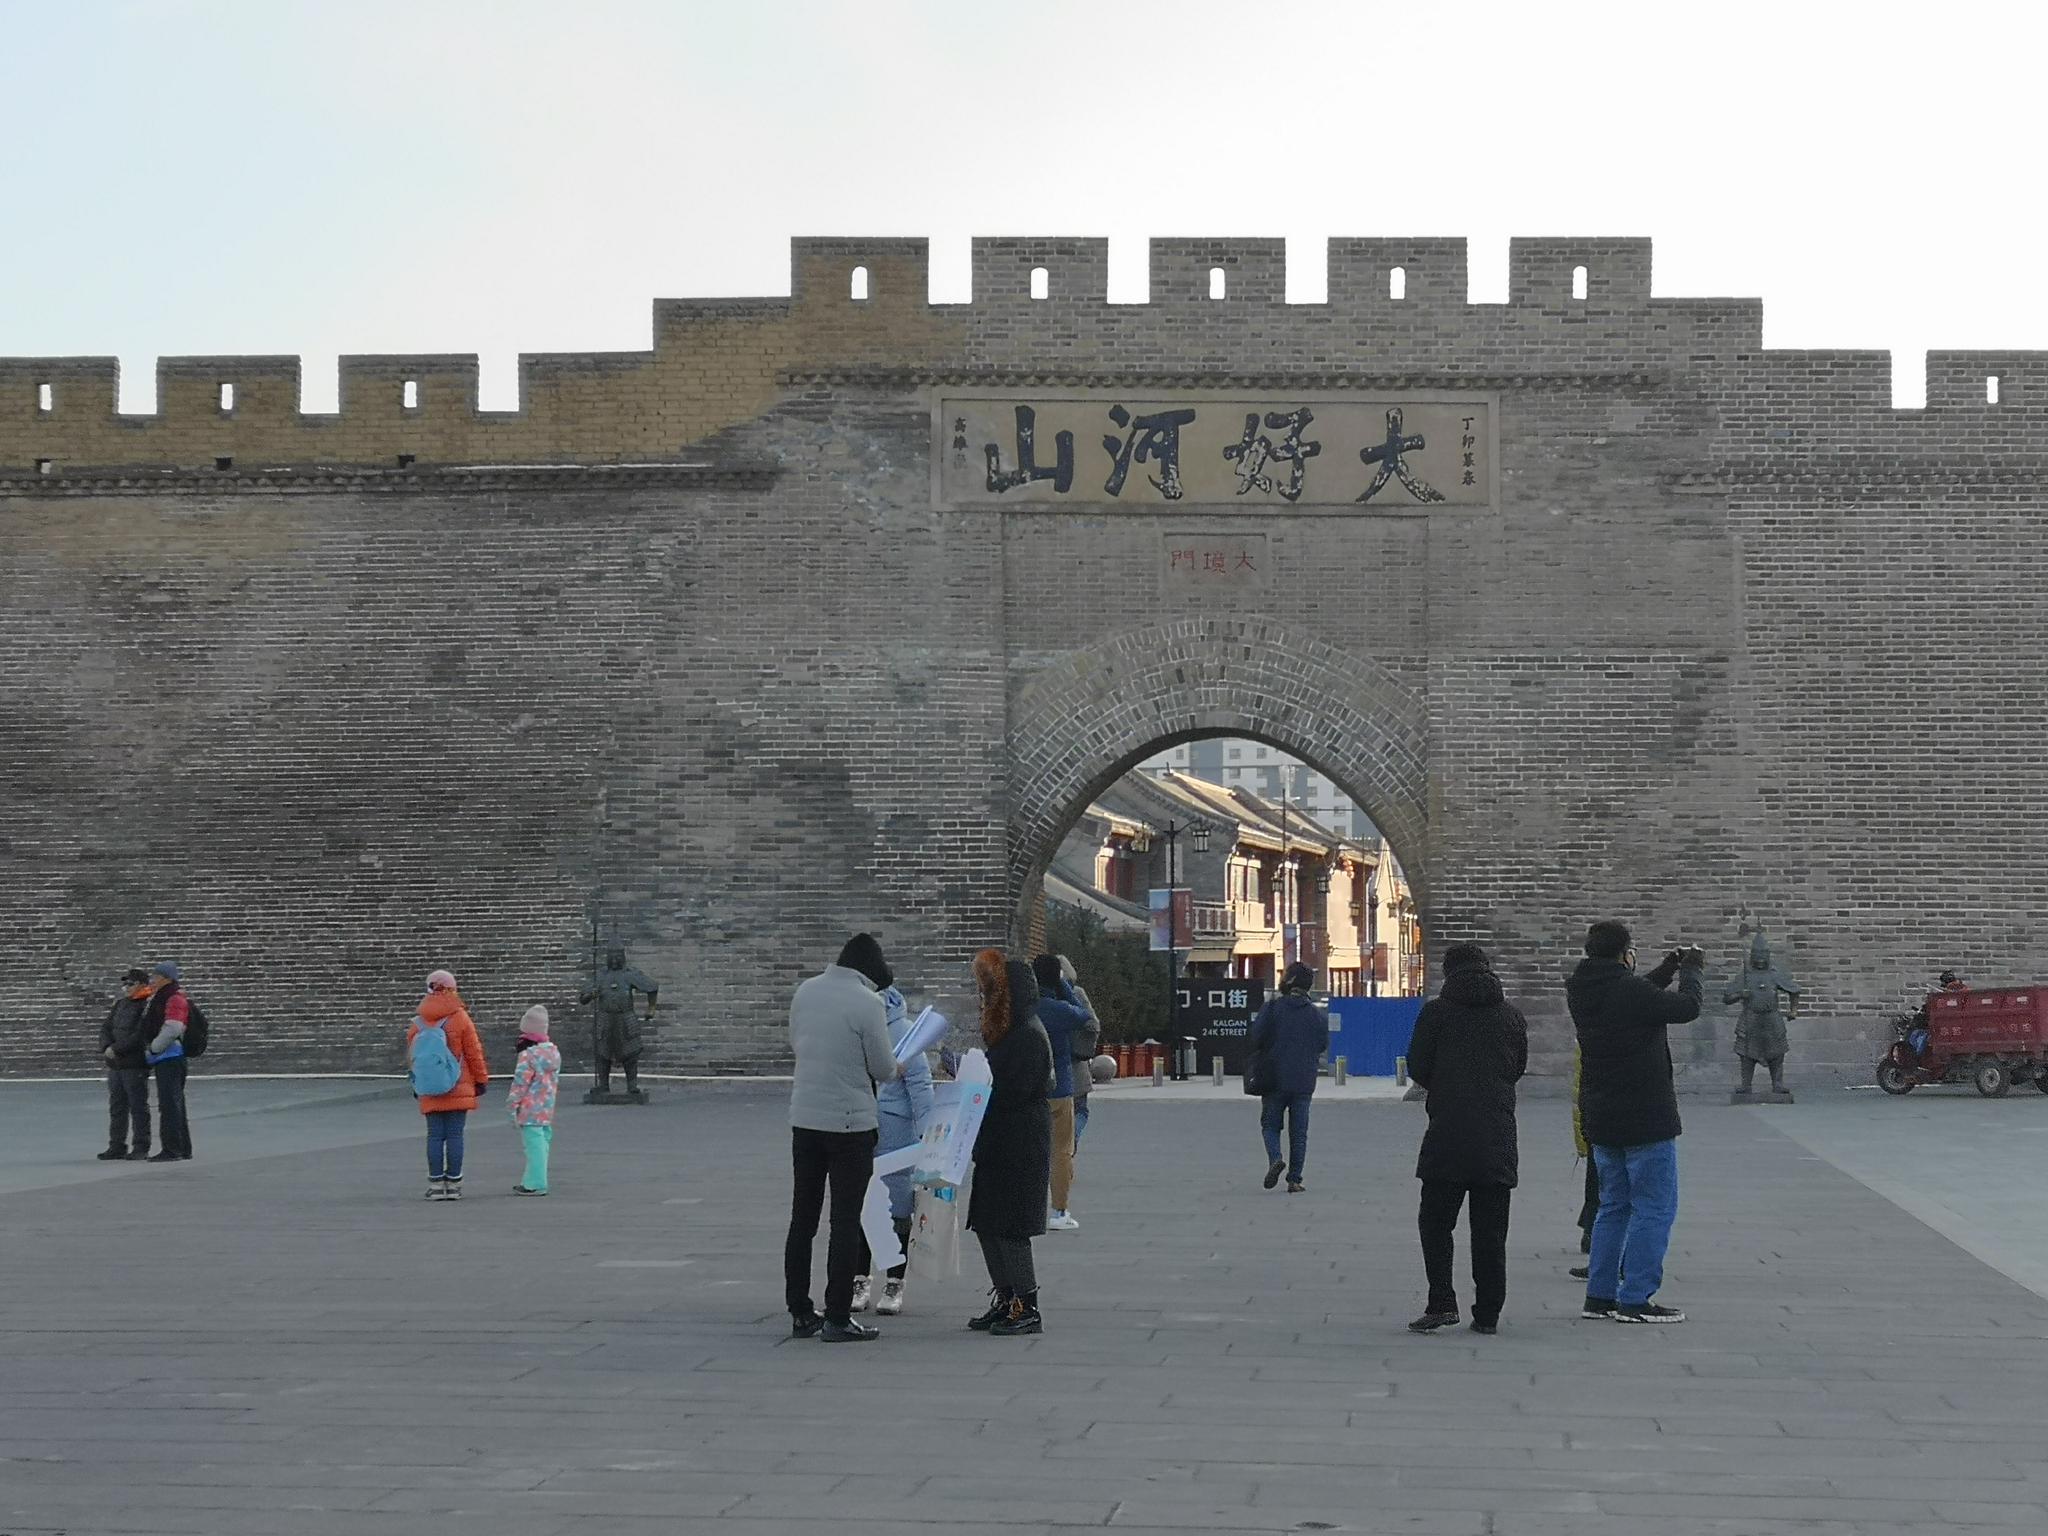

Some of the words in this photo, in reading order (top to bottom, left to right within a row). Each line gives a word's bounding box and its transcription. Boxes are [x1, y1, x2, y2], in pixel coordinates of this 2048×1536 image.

[1213, 1019, 1247, 1027] KALGAN
[1202, 1028, 1218, 1036] 24K
[1220, 1028, 1248, 1036] STREET
